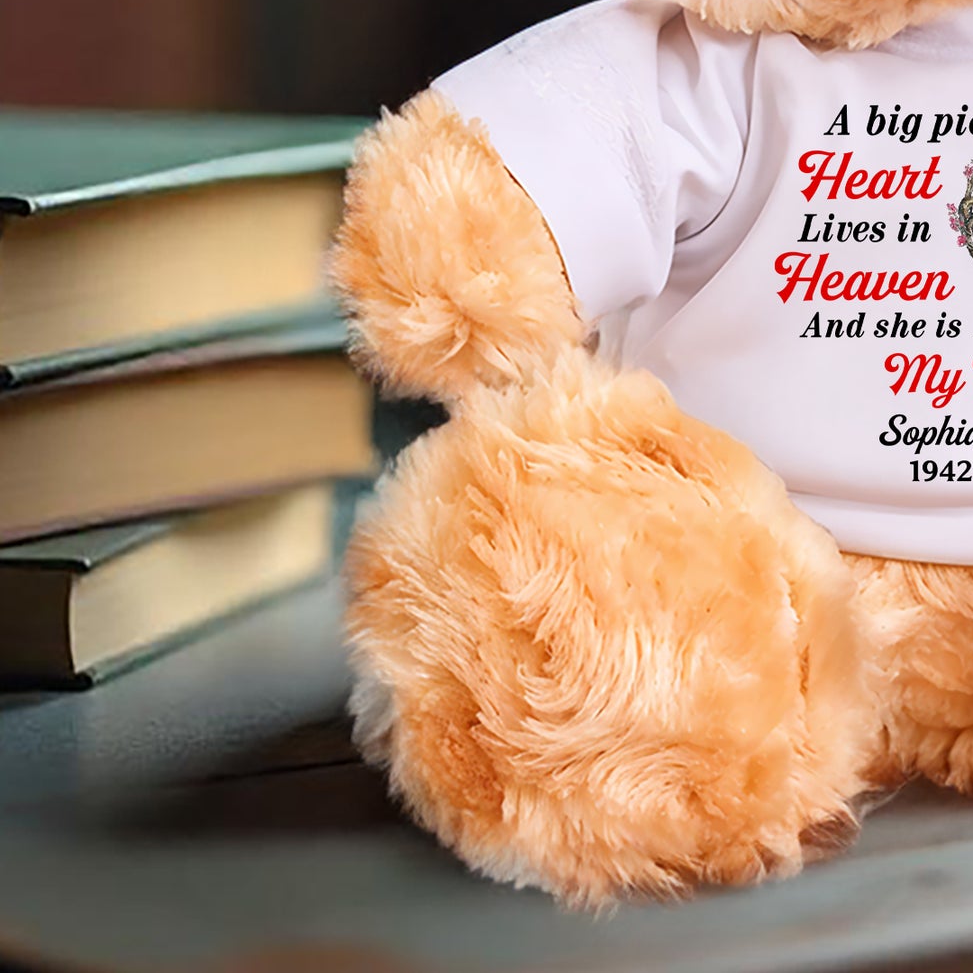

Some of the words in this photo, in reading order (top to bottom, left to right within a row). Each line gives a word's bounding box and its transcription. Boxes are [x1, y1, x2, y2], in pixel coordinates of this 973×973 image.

[824, 104, 851, 137] A
[866, 104, 923, 144] big
[797, 149, 943, 203] Heart
[796, 212, 887, 244] Lives
[896, 212, 932, 244] in
[774, 251, 956, 305] Heaven
[799, 311, 867, 339] And
[872, 311, 927, 339] she
[934, 311, 963, 339] is
[883, 352, 967, 409] My
